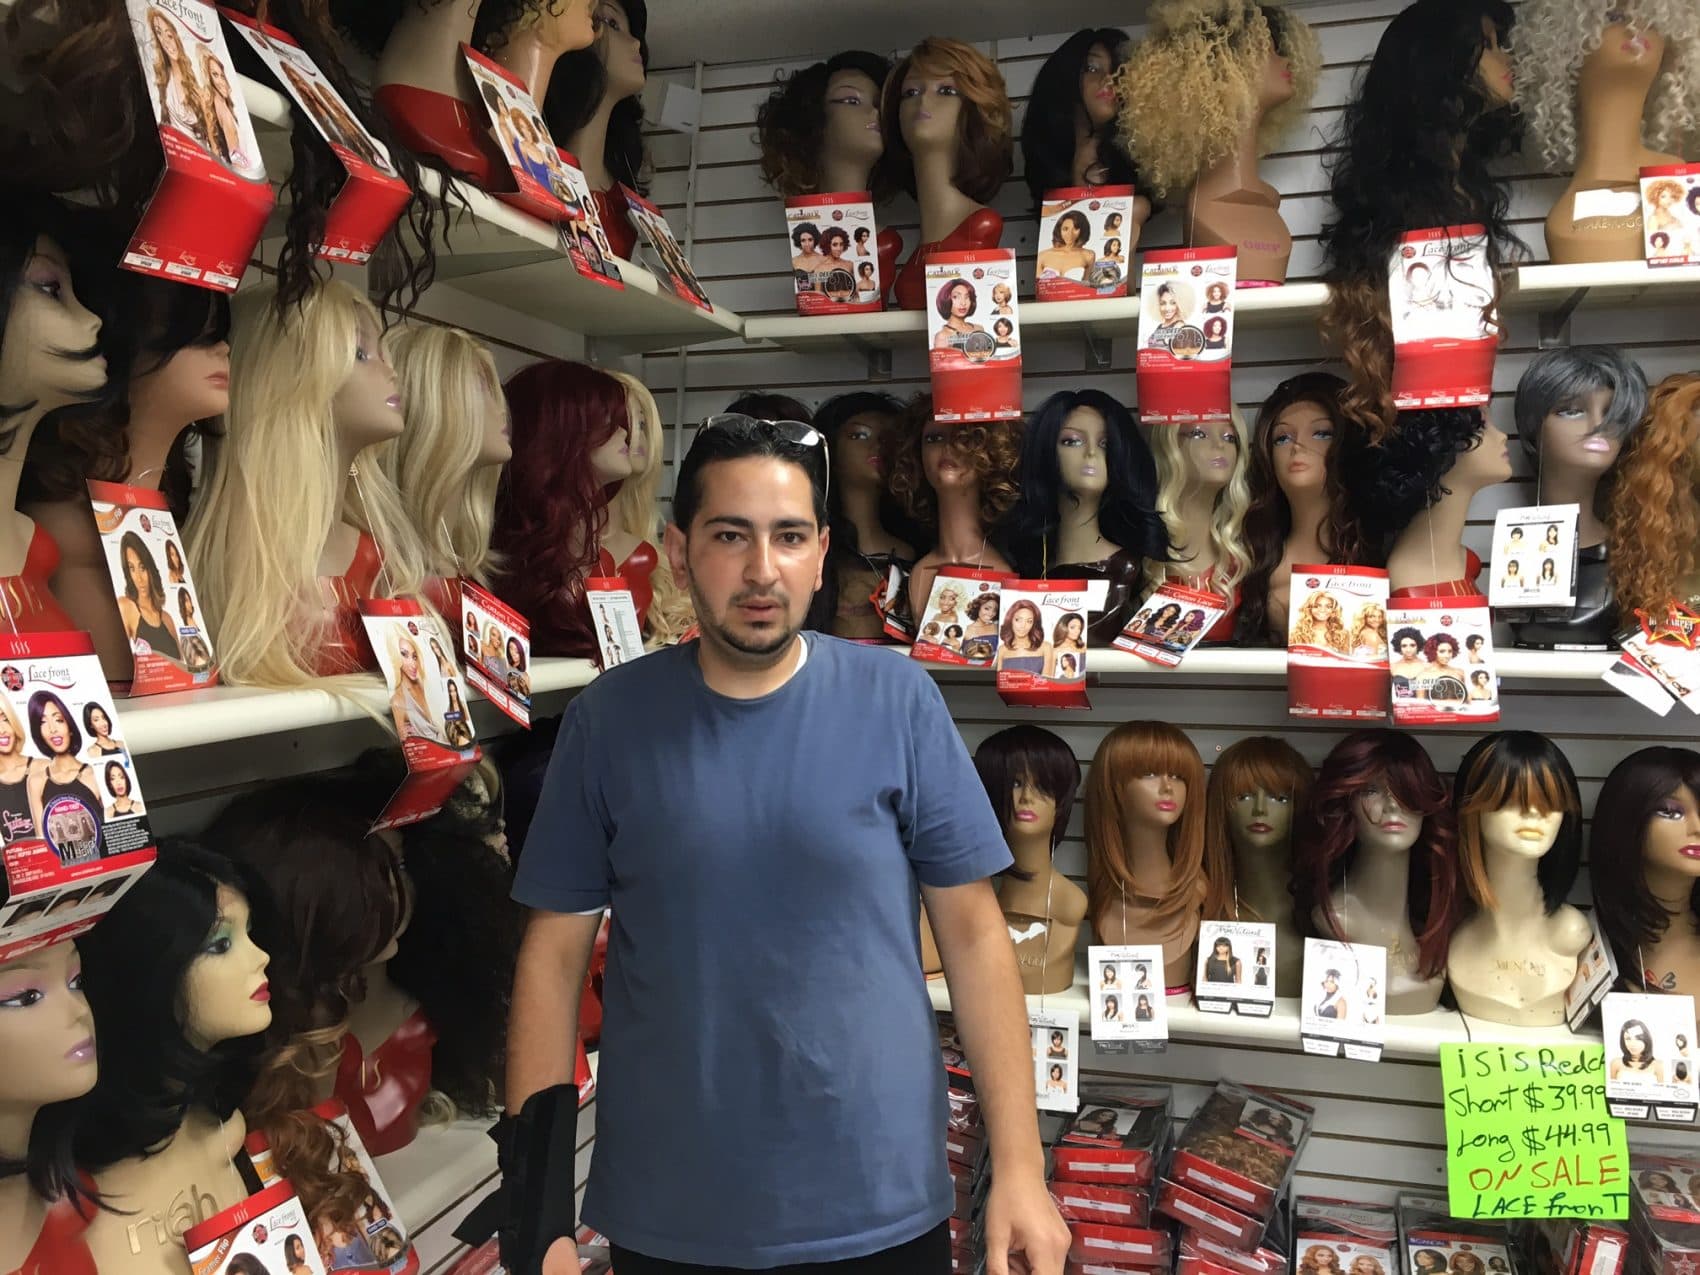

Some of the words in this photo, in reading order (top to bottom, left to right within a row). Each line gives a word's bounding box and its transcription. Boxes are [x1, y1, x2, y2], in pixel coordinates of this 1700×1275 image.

[10, 640, 31, 655] ISIS
[28, 664, 48, 683] Lace
[48, 666, 70, 680] front
[1449, 1084, 1519, 1117] Short
[1456, 1129, 1516, 1163] Long
[1468, 1163, 1523, 1191] ON
[1530, 1154, 1621, 1189] SALE
[1472, 1193, 1536, 1218] LACE
